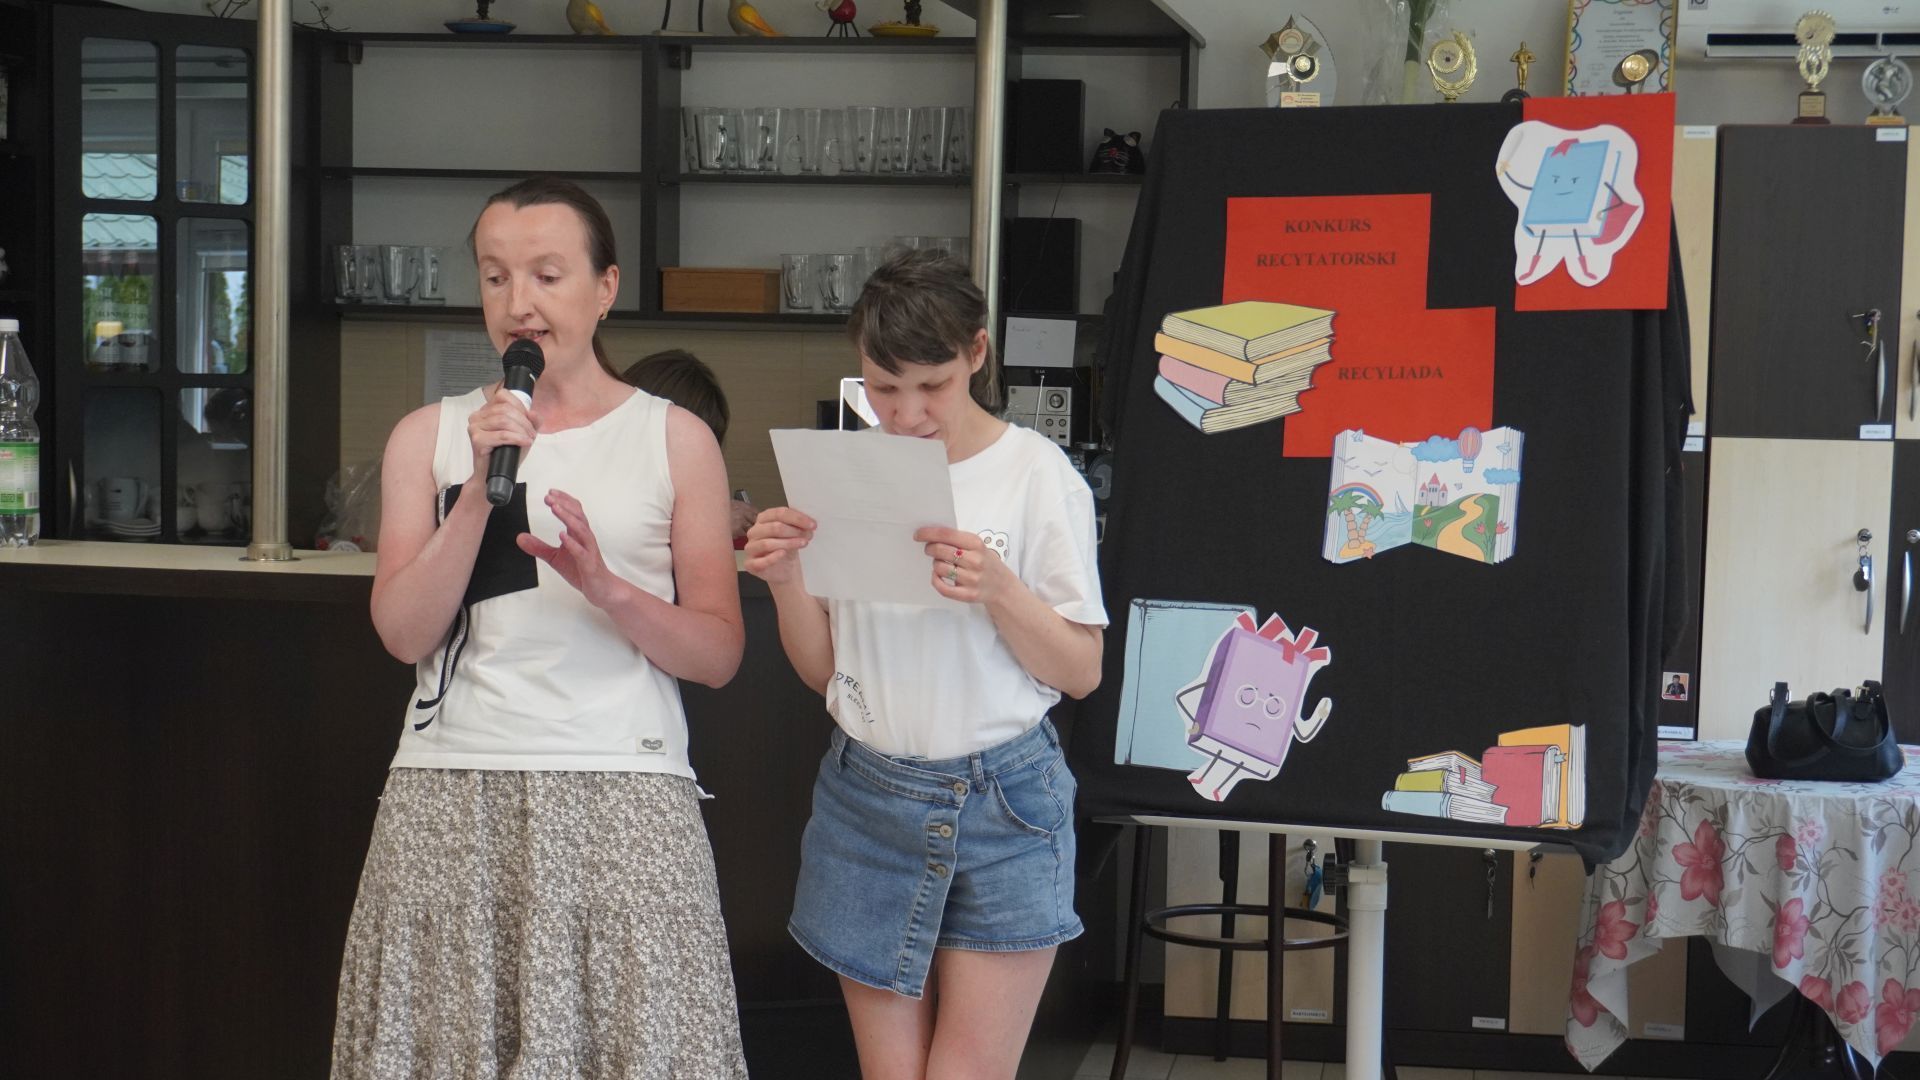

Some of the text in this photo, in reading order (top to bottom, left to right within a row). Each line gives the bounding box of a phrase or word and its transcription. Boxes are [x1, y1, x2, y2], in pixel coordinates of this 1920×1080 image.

[1284, 218, 1372, 233] KONKURS
[1256, 251, 1397, 267] RECYTATORSKI
[1338, 366, 1444, 380] RECYLIADA
